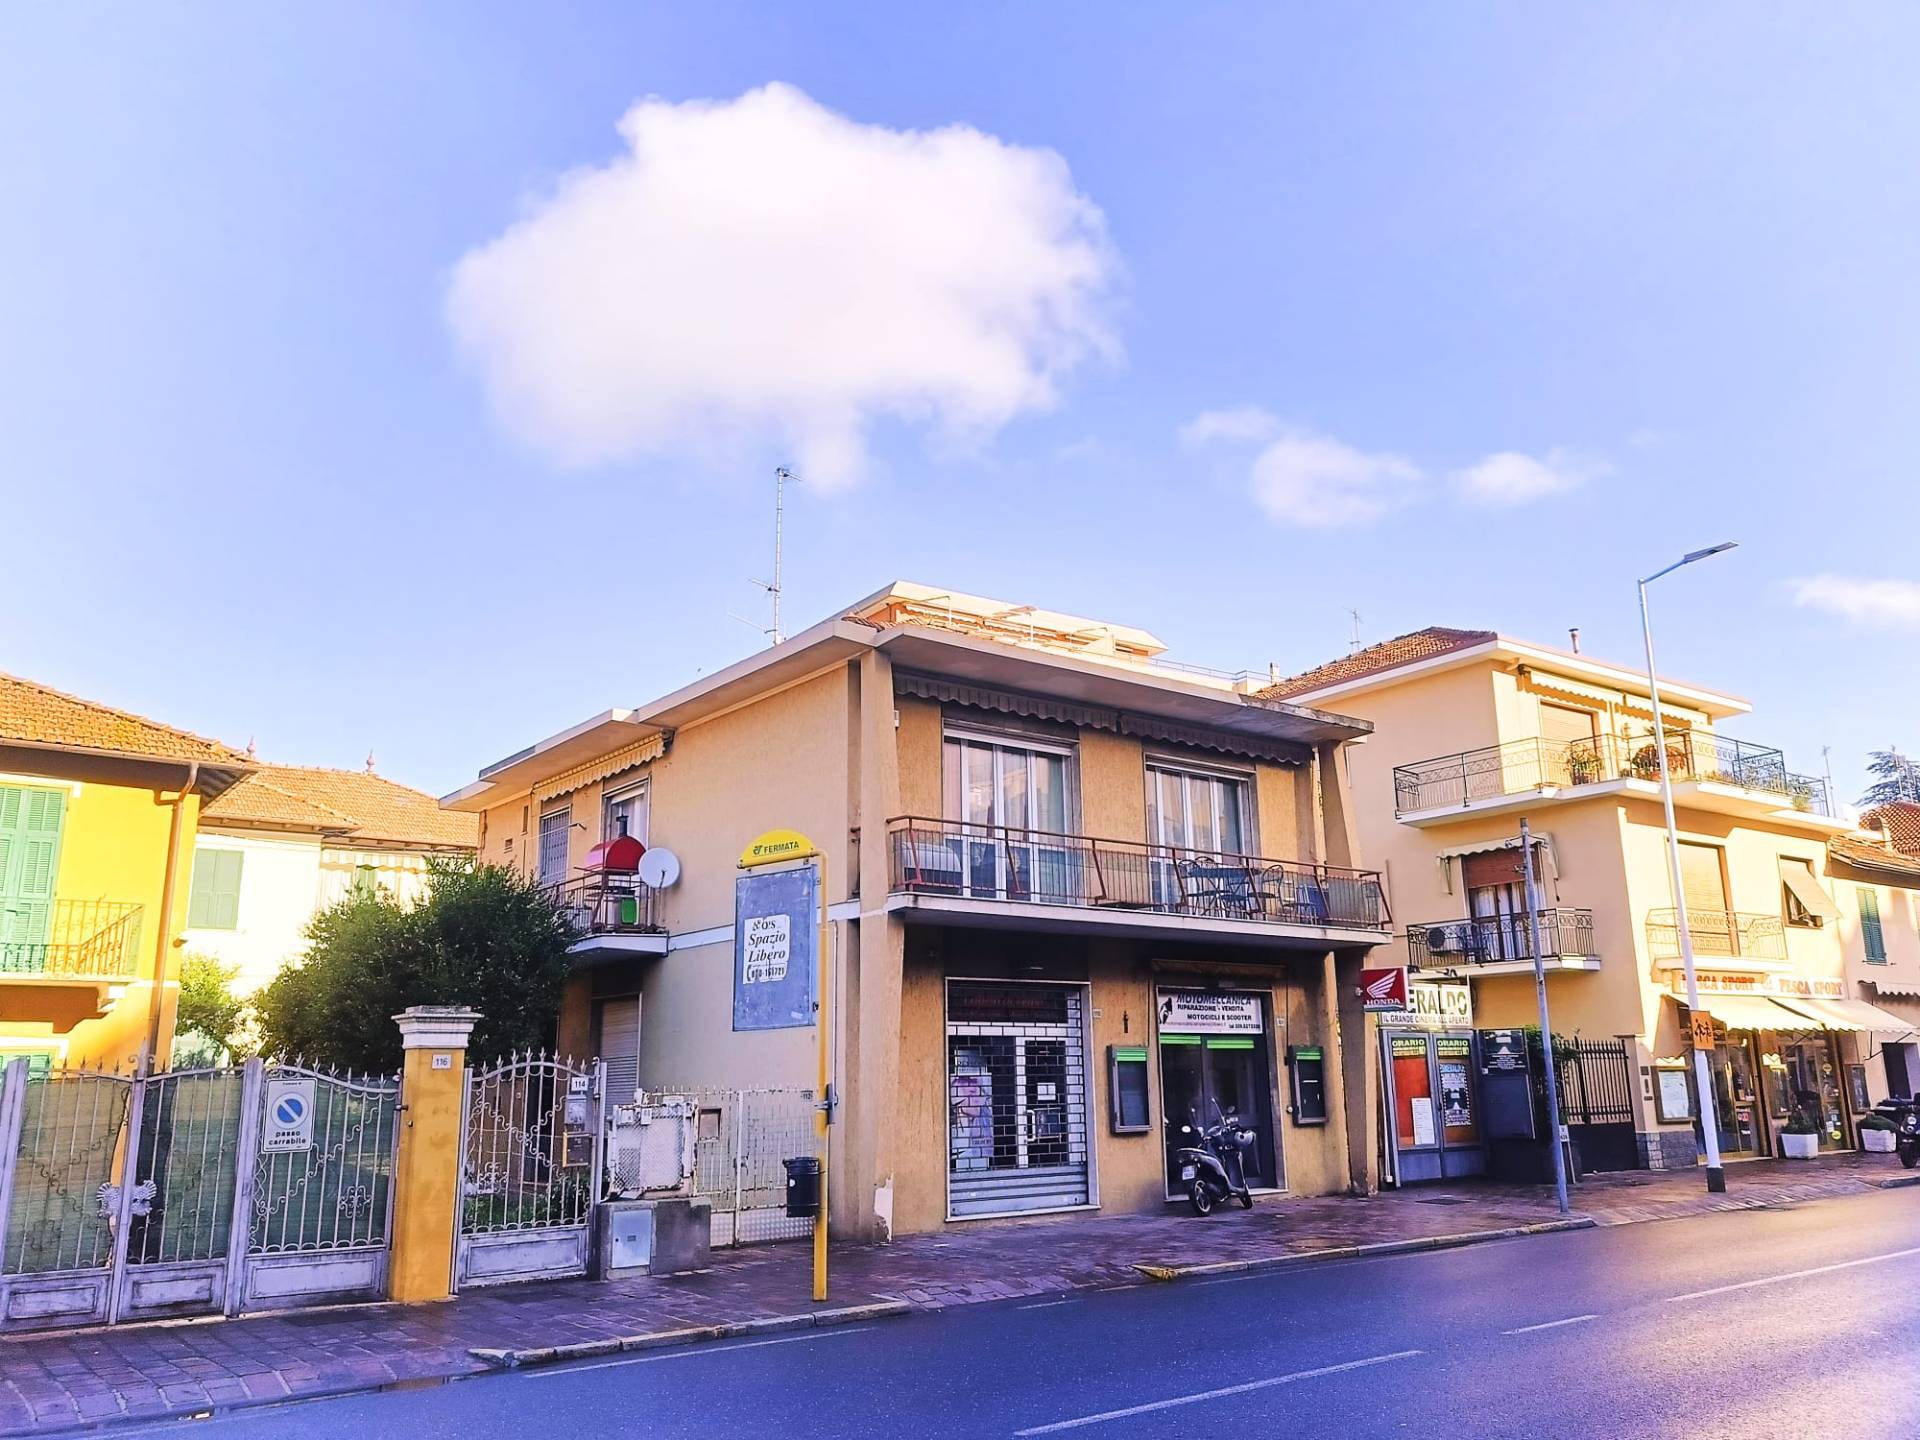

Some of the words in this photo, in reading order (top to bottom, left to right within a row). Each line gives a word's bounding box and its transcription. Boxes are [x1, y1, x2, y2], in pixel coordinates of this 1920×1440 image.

[764, 841, 799, 854] FERMATA
[748, 930, 786, 948] Spazio
[748, 949, 786, 962] Libero
[1682, 974, 1718, 991] PSCA
[1721, 975, 1755, 991] SPORT
[1779, 977, 1812, 995] PESCA
[1814, 981, 1843, 996] SPORT
[1176, 994, 1252, 1006] MOTOMECCANICA
[1366, 998, 1401, 1006] HONDA
[1390, 1015, 1414, 1023] GRANDE
[1392, 1039, 1425, 1047] ORARIO
[436, 1058, 448, 1066] 116
[275, 1130, 301, 1138] passo
